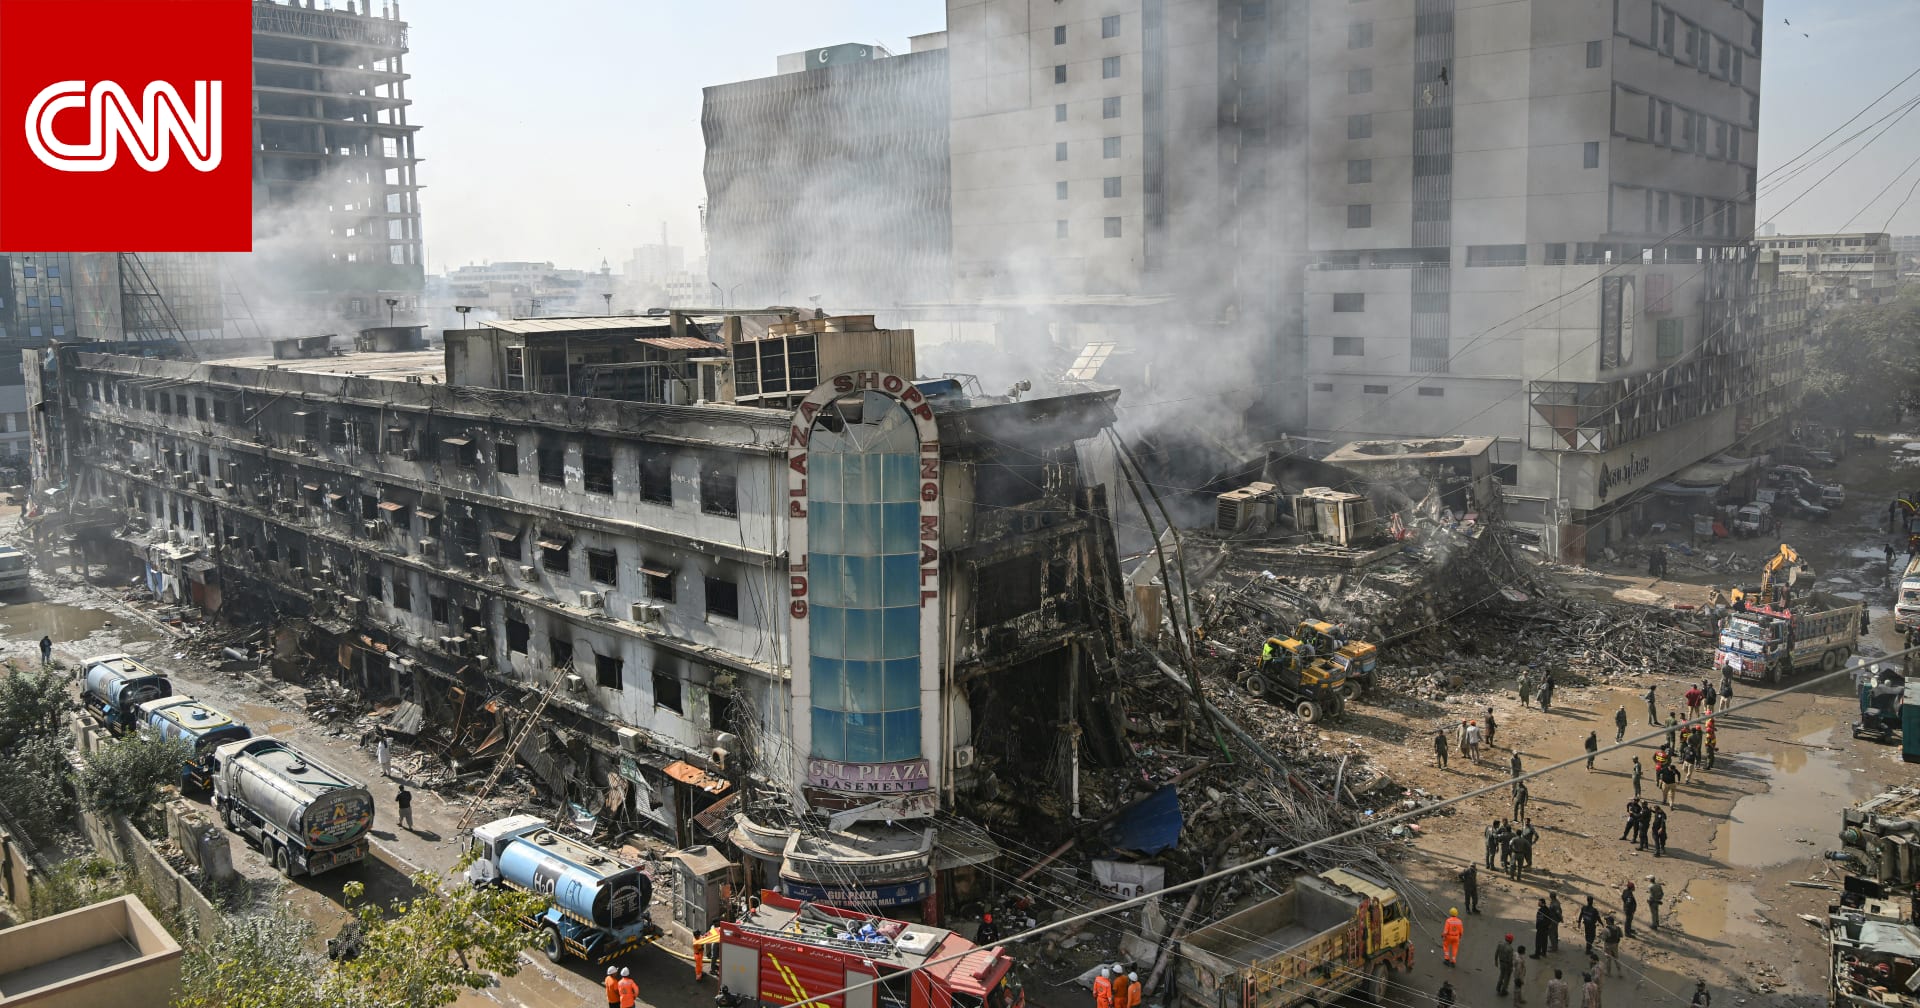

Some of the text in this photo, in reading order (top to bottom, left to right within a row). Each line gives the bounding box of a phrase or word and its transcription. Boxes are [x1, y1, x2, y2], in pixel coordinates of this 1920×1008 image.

[790, 401, 821, 518] PLAZA
[920, 515, 938, 609] MALL
[790, 555, 808, 619] GUL
[808, 760, 929, 781] GUL PLAZA
[820, 778, 917, 792] BASEMENT
[828, 890, 879, 900] GUL PLAZA
[878, 897, 896, 906] MALL
